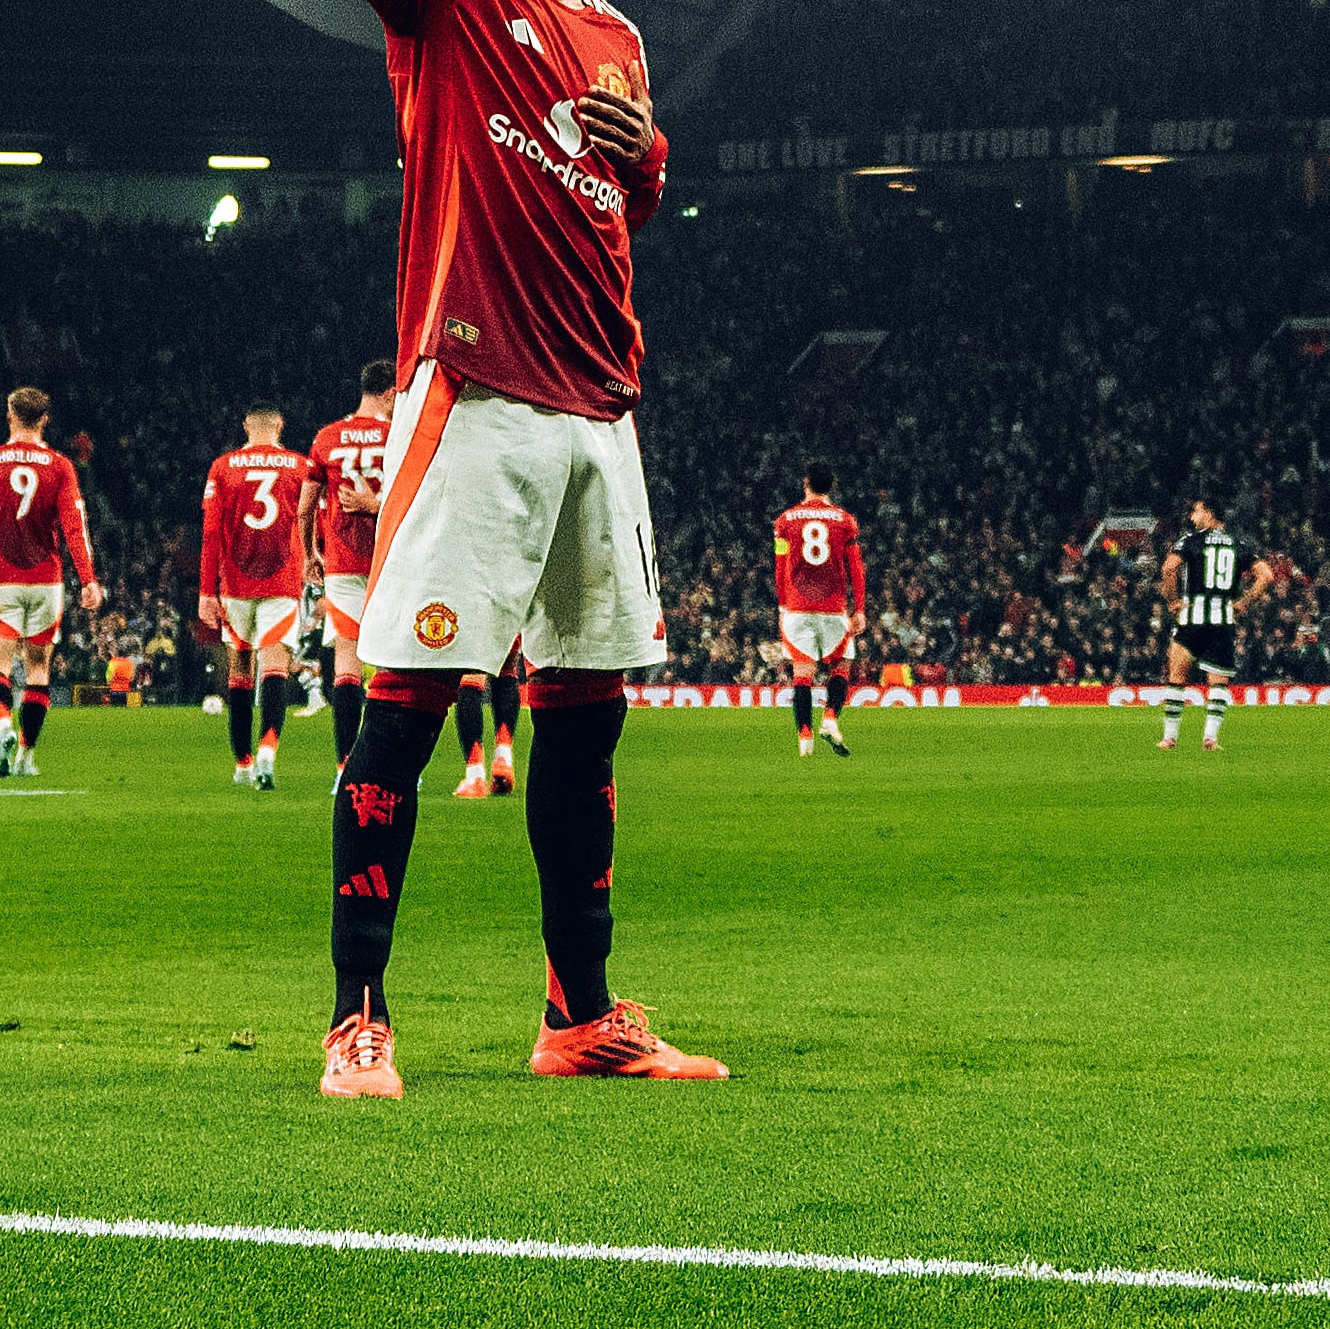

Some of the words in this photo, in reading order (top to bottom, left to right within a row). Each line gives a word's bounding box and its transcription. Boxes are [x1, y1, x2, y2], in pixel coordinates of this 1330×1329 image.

[882, 126, 1050, 165] STRETFORD
[1060, 123, 1116, 157] END
[340, 429, 382, 444] EVANS
[228, 454, 297, 469] MAZRAOUI
[328, 446, 385, 501] 35
[10, 466, 38, 519] 9
[243, 470, 279, 529] 3
[802, 520, 830, 563] 8
[1204, 546, 1234, 590] 19
